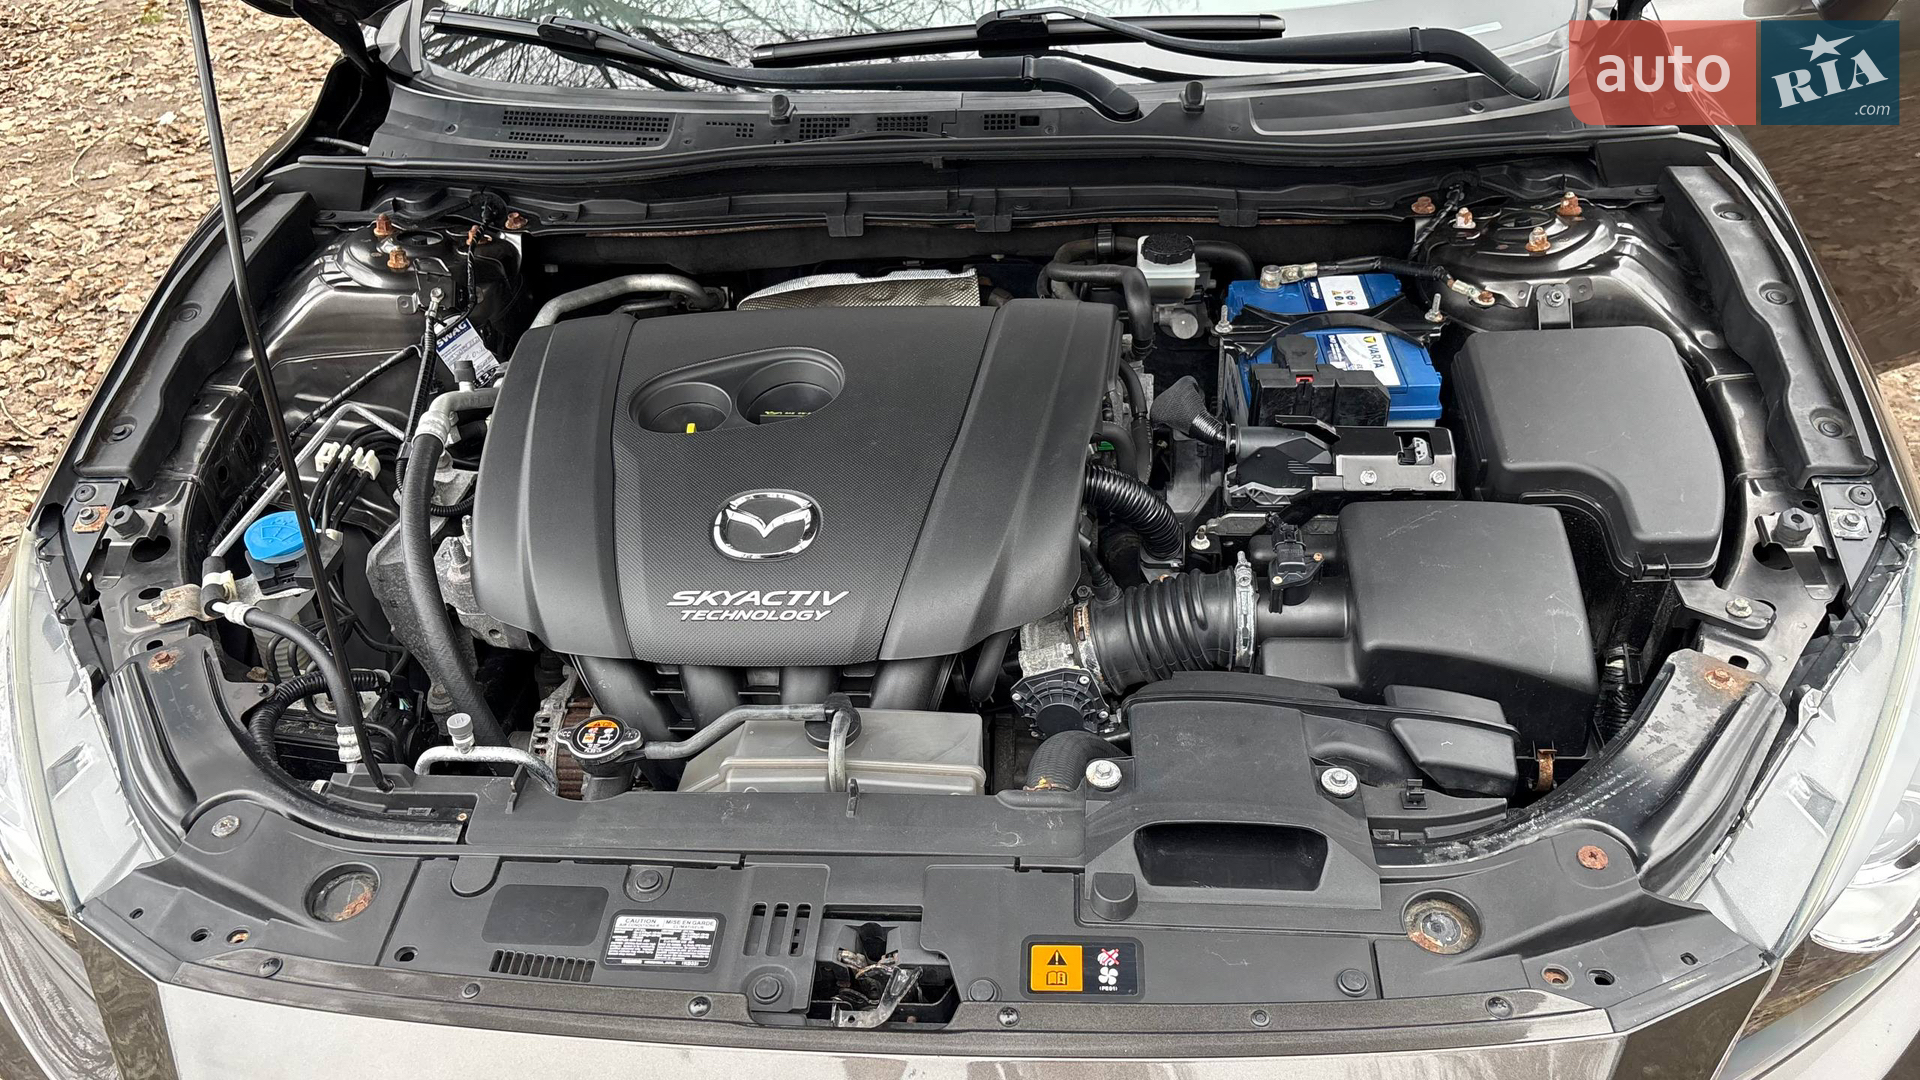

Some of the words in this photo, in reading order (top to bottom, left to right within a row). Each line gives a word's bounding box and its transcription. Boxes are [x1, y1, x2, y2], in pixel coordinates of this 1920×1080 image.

[436, 321, 468, 348] SWAG
[1367, 344, 1385, 369] VARTA
[666, 590, 850, 606] SKYACTIV
[680, 609, 832, 621] TECHNOLOGY
